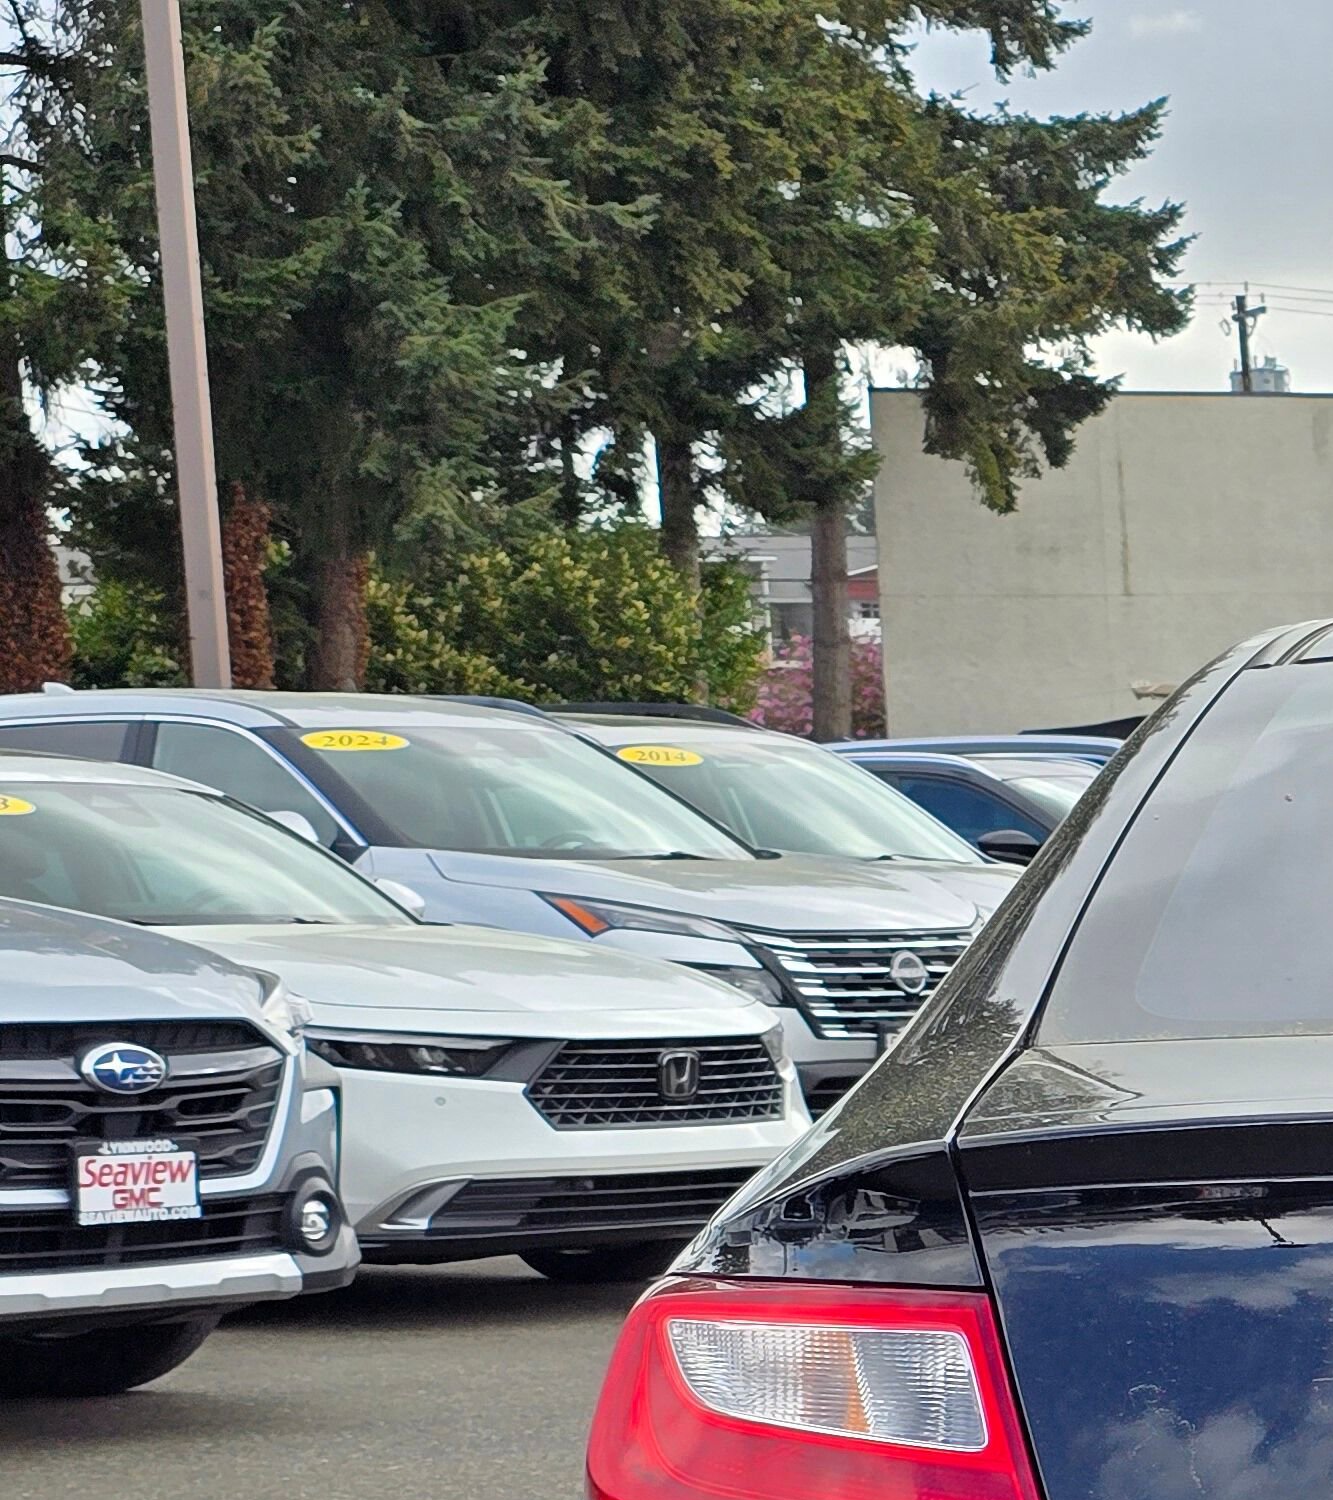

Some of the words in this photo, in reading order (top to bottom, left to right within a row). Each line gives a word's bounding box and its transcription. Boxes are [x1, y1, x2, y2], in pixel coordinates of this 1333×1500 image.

[322, 735, 388, 747] 2024
[635, 750, 686, 761] 2014
[80, 1155, 194, 1188] Seaview
[113, 1187, 164, 1209] GMC
